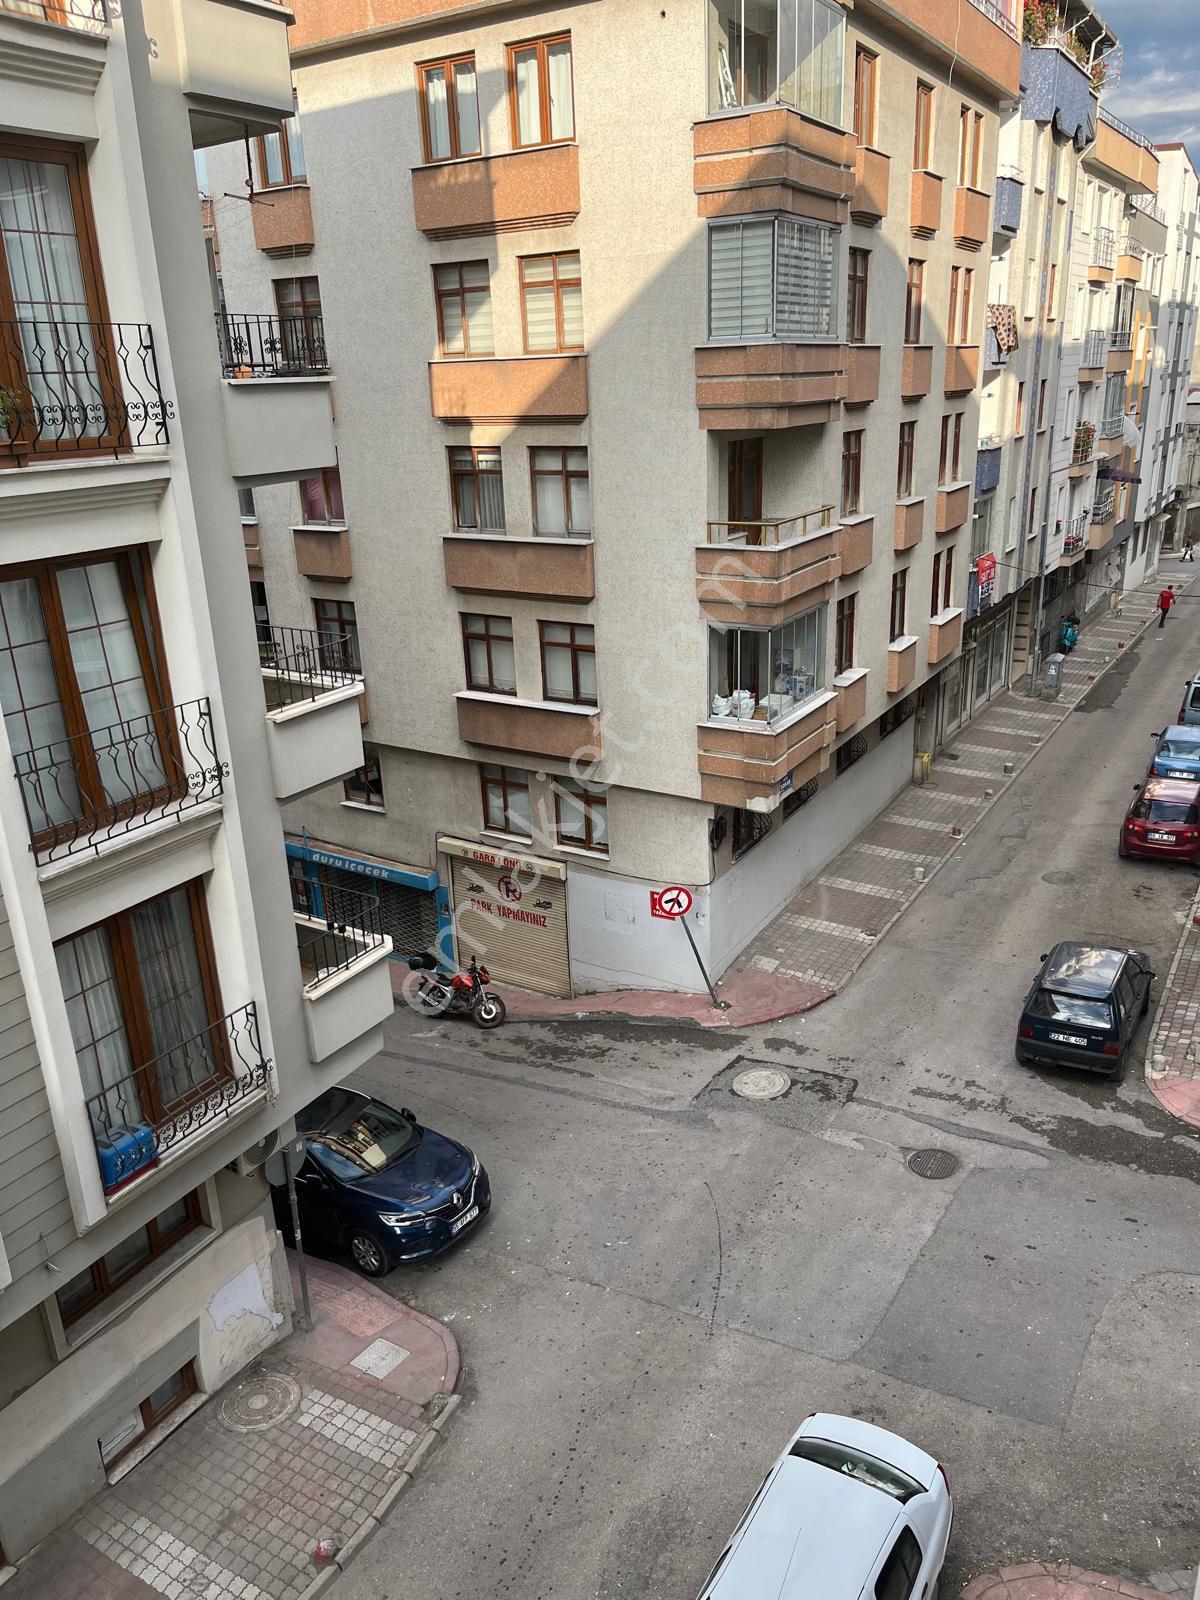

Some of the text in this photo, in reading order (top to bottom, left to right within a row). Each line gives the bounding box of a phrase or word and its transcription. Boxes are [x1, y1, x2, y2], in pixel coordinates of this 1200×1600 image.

[312, 853, 389, 878] duru içecek
[470, 898, 492, 914] PARK
[496, 903, 548, 928] YAPMAYINIZ
